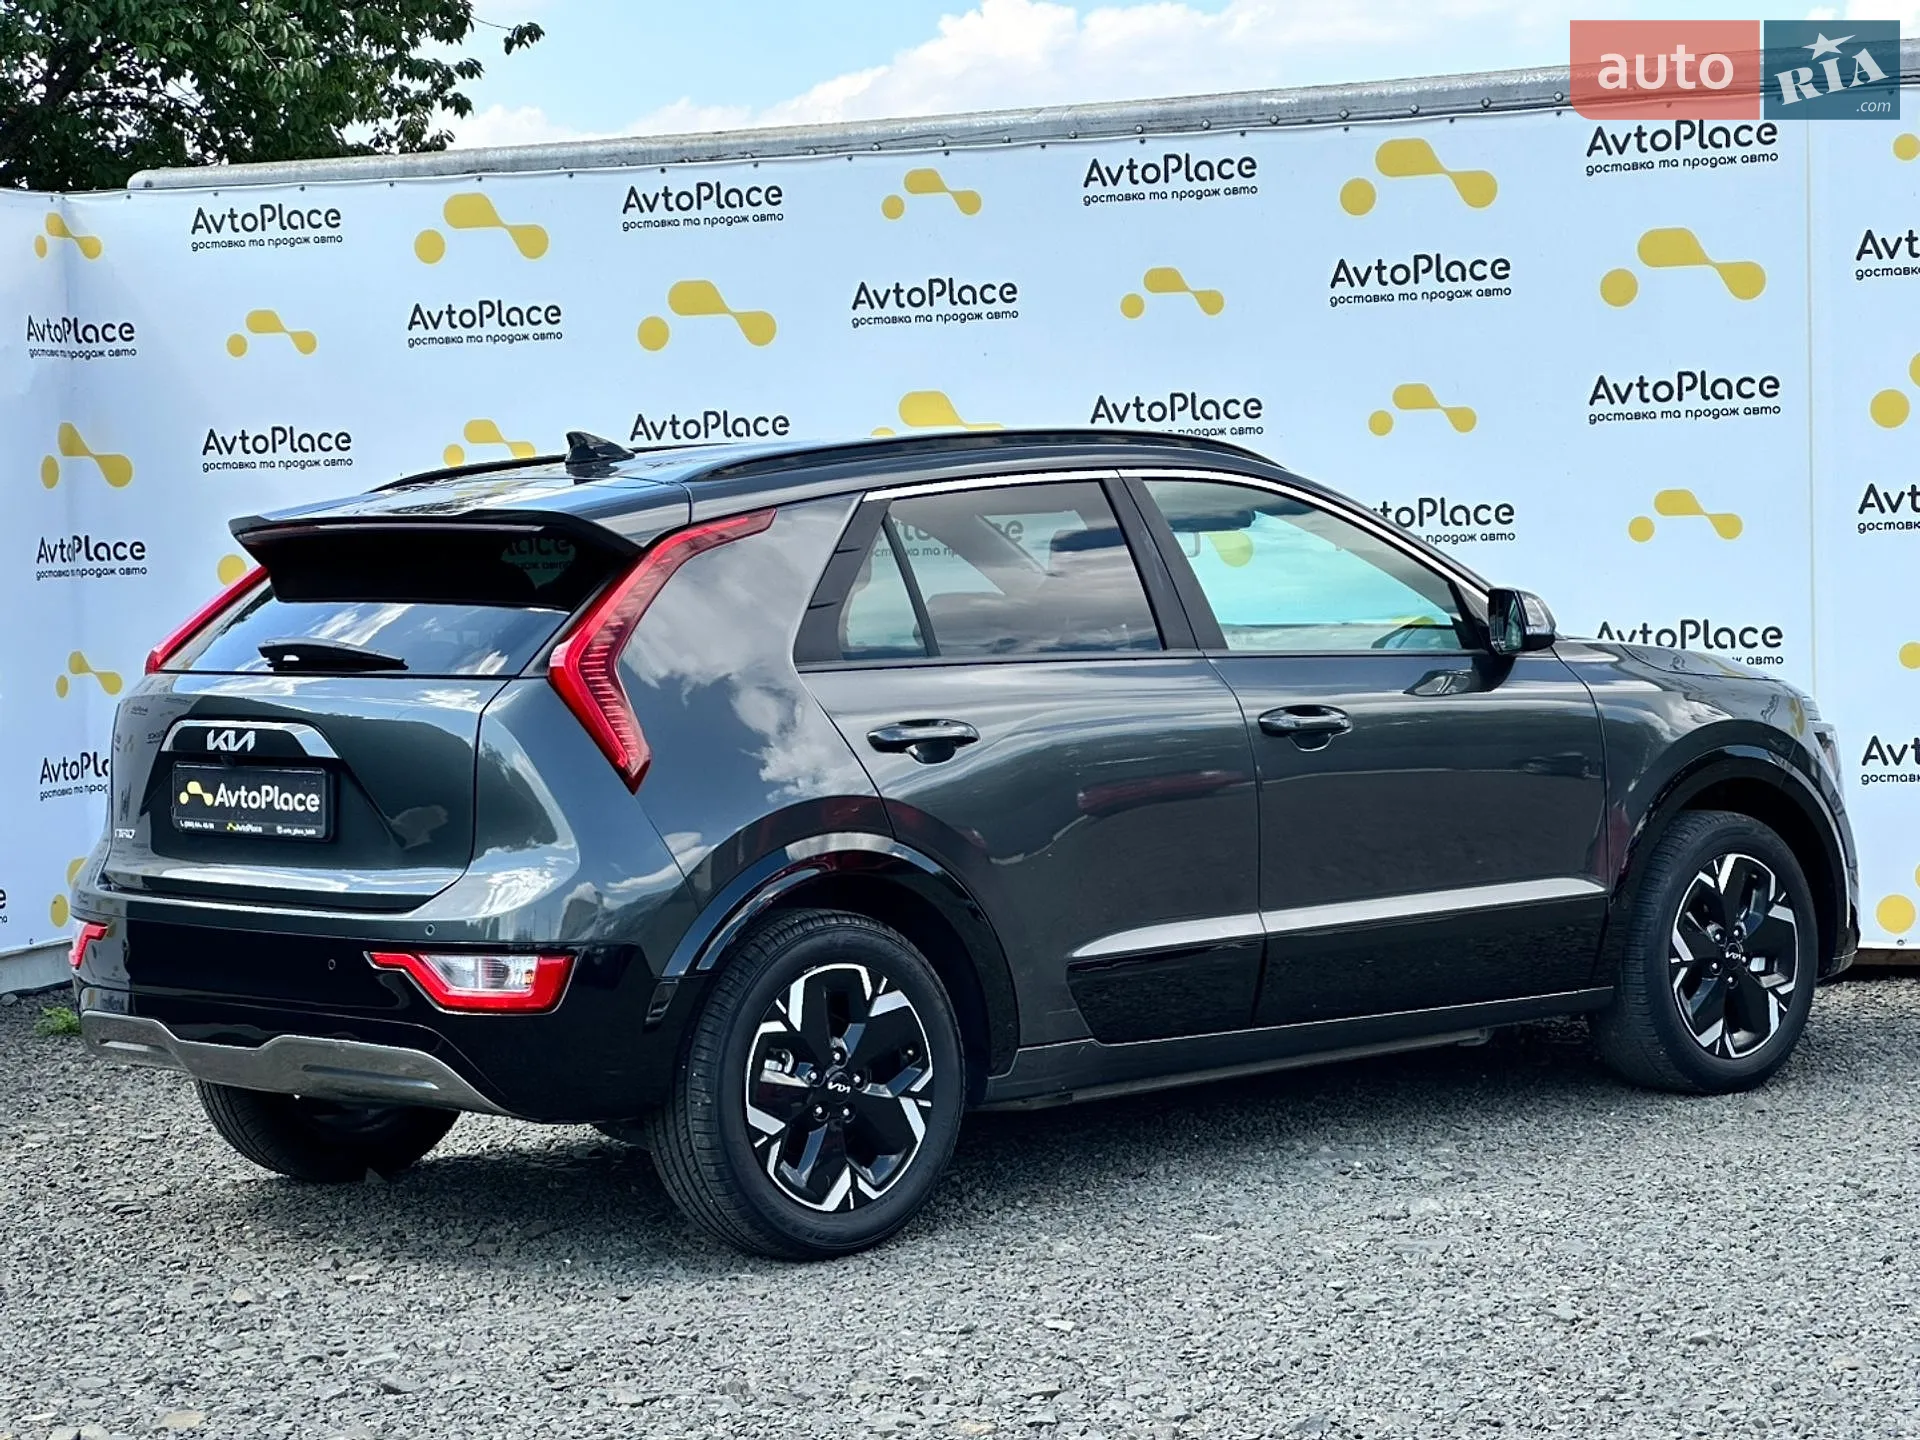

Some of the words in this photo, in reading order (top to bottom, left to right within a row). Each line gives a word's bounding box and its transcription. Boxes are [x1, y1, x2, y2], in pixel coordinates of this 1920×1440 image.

[1587, 119, 1777, 157] AvtoPlace
[1084, 153, 1257, 188] AvtoPlace
[1586, 161, 1654, 176] доставка
[1683, 156, 1736, 170] продаж
[1741, 153, 1778, 163] авто
[623, 182, 782, 214] AvtoPlace
[1083, 191, 1145, 206] доставка
[1172, 188, 1220, 201] продаж
[1224, 186, 1258, 195] авто
[191, 204, 341, 234] AvtoPlace
[623, 219, 680, 232] доставка
[704, 215, 749, 228] продаж
[752, 213, 783, 223] авто
[191, 239, 246, 252] доставка
[268, 237, 310, 248] продаж
[314, 235, 343, 244] авто
[1330, 254, 1511, 288] AvtoPlace
[1856, 267, 1920, 281] доставк
[852, 278, 1018, 310] AvtoPlace
[1330, 293, 1394, 307] доставка
[1421, 290, 1472, 303] продаж
[1476, 288, 1512, 297] авто
[27, 315, 135, 344] AvtoPlace
[408, 300, 561, 331] AvtoPlace
[852, 315, 912, 328] доставка
[936, 312, 982, 324] продаж
[986, 310, 1018, 319] авто
[408, 336, 463, 348] доставка
[486, 333, 529, 345] продаж
[532, 331, 563, 340] авто
[1589, 370, 1780, 406] AvtoPlace
[1090, 391, 1263, 424] AvtoPlace
[1589, 410, 1656, 424] доставка
[1686, 407, 1739, 420] продаж
[1743, 405, 1781, 415] авто
[202, 426, 351, 456] AvtoPlace
[630, 410, 790, 442] AvtoPlace
[202, 462, 256, 473] доставка
[279, 459, 320, 470] продаж
[324, 457, 353, 467] авто
[1373, 497, 1515, 527] toPlace
[207, 729, 256, 751] KIA
[214, 782, 320, 812] AvtoPlace
